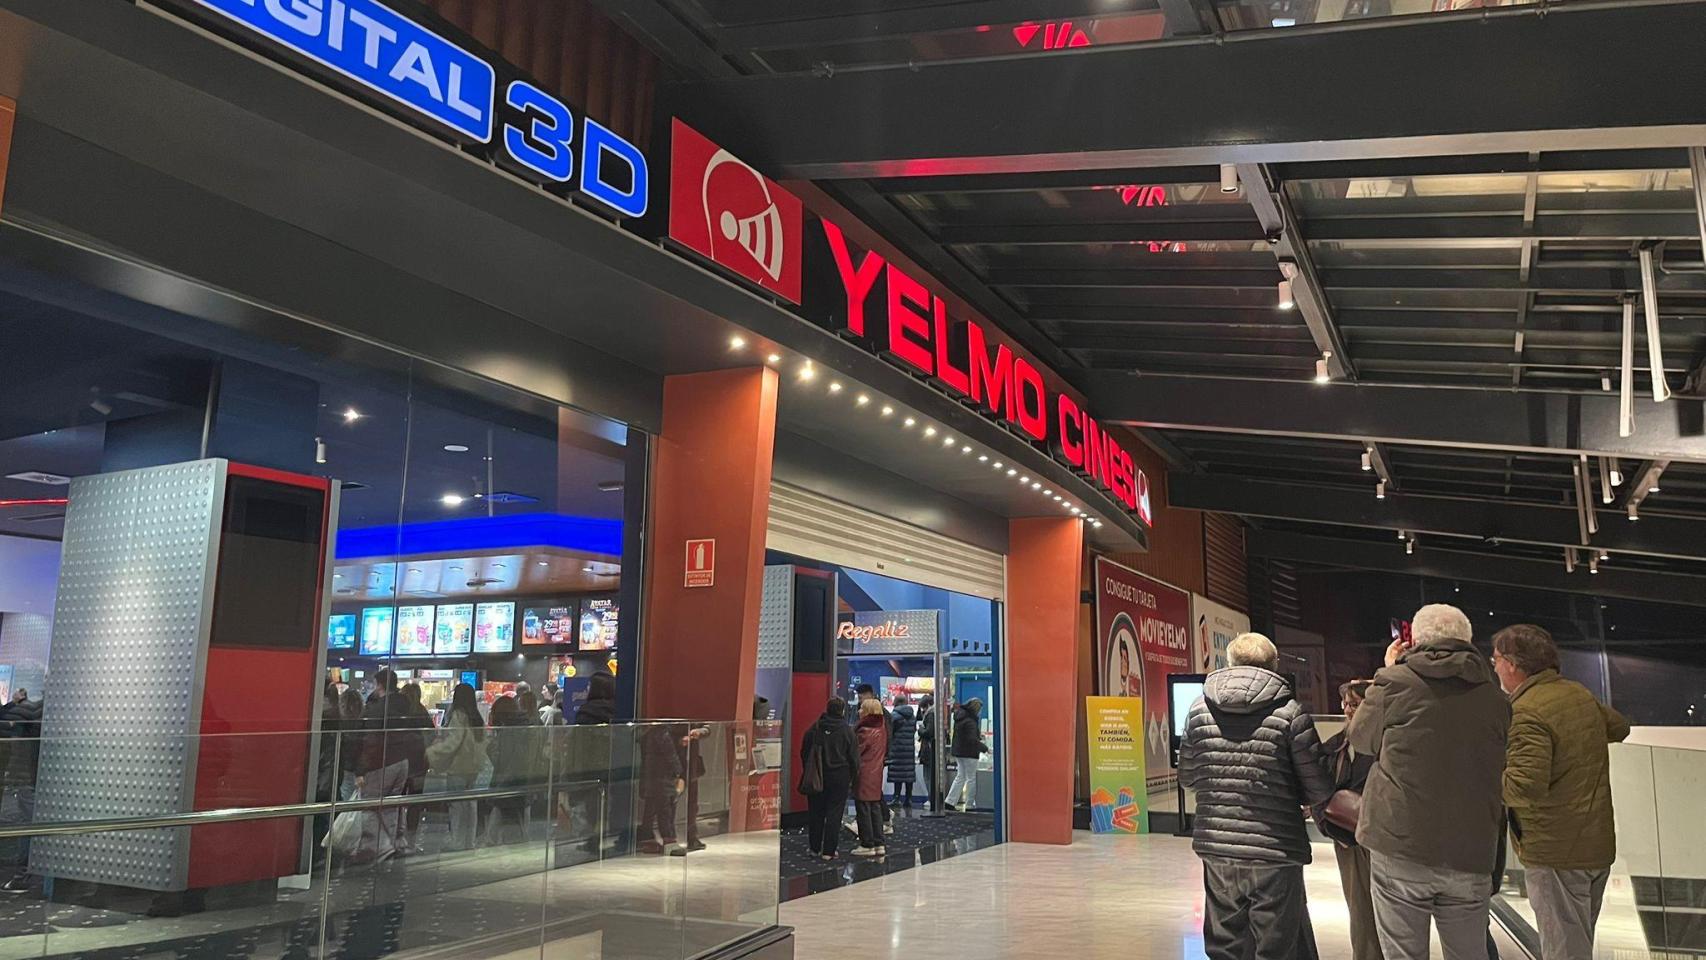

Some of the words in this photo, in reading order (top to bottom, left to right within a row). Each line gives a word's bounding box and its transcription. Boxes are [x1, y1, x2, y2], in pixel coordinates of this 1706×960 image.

[238, 0, 482, 122] GITAL
[502, 80, 648, 218] 3D
[820, 216, 1047, 441] YELMO
[1058, 393, 1136, 510] CINES
[1105, 577, 1132, 602] CONSIGUE
[1139, 590, 1157, 609] TARJETA
[837, 621, 910, 644] Regaliz
[1140, 616, 1187, 651] MOVIEYELMO
